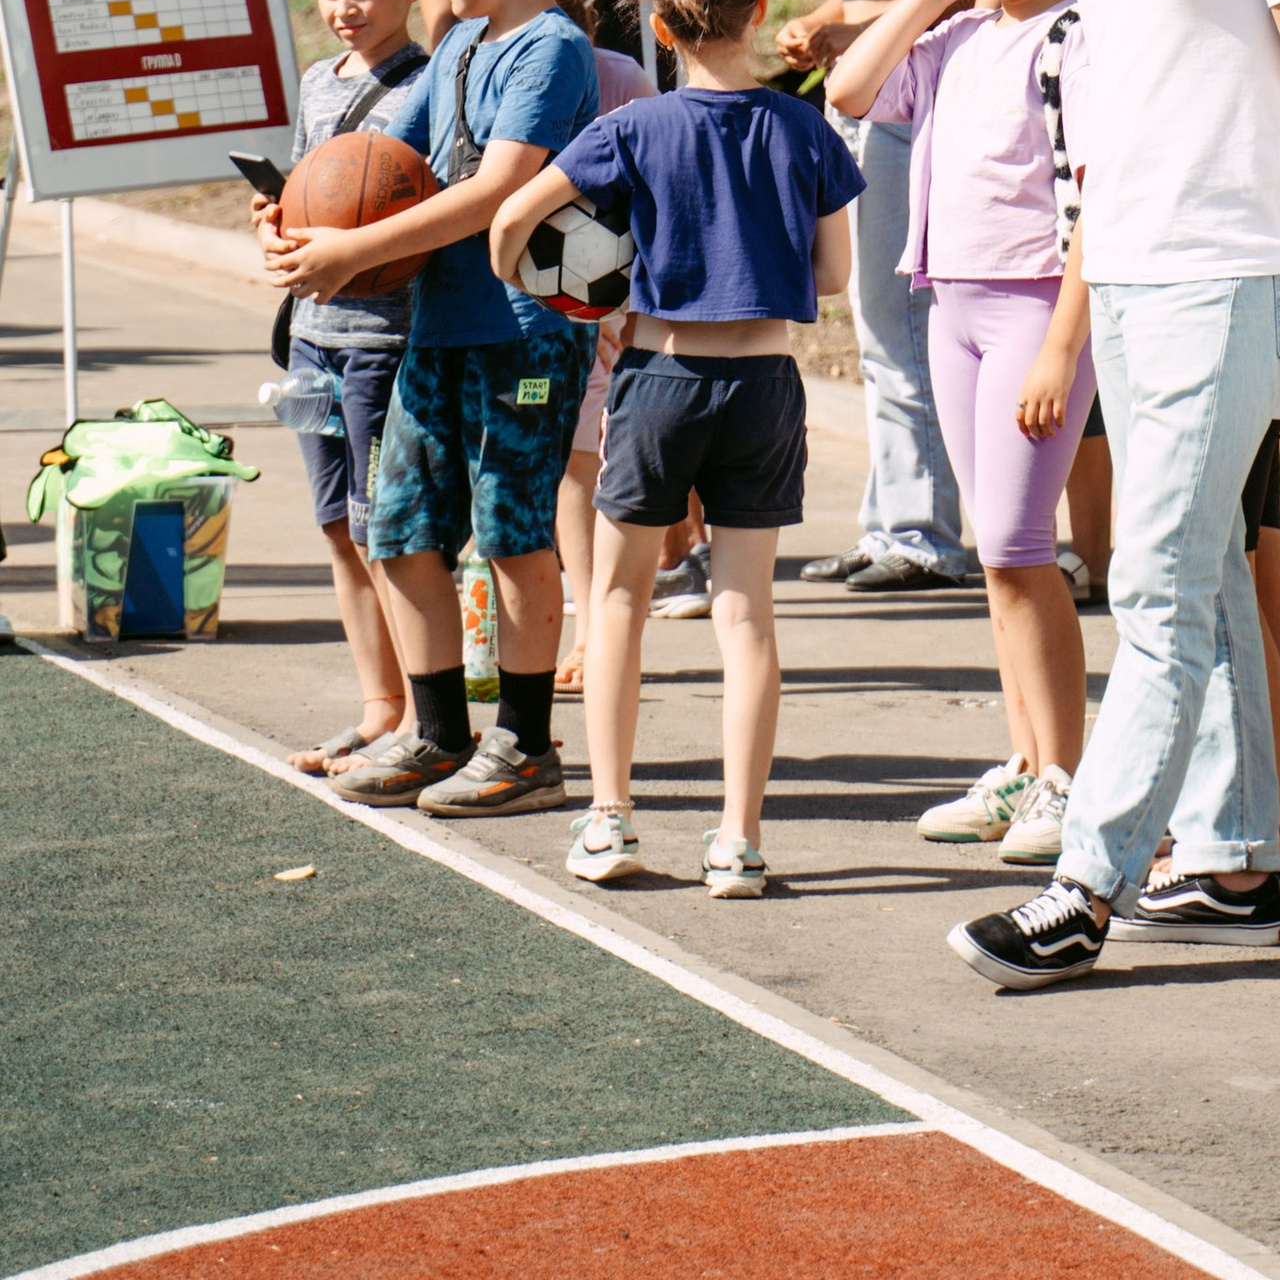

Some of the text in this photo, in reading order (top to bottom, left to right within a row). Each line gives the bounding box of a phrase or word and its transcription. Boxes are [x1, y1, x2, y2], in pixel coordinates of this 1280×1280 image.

[141, 53, 175, 70] ГРУППА
[373, 151, 392, 211] adidas
[523, 381, 547, 390] START
